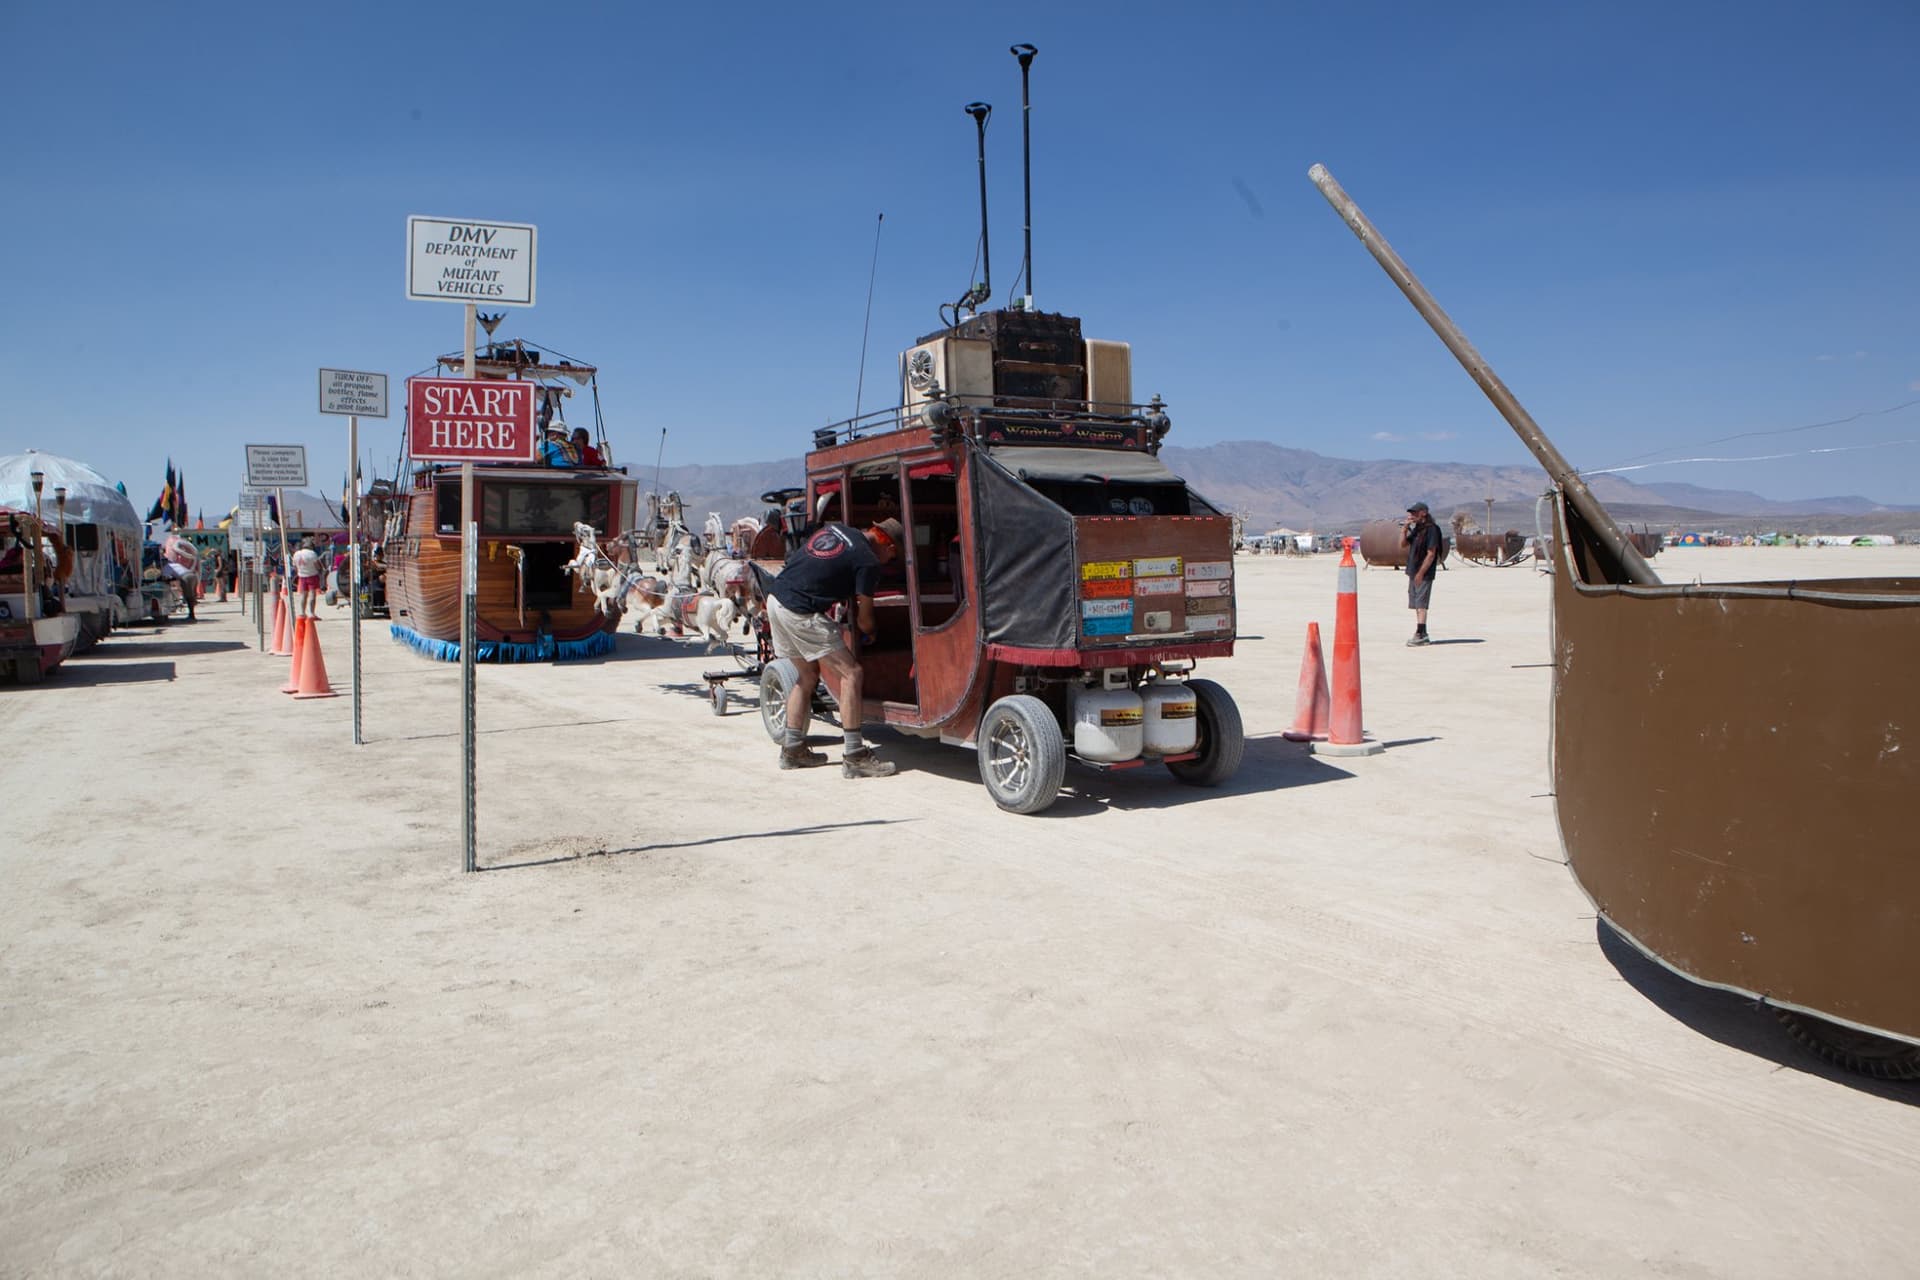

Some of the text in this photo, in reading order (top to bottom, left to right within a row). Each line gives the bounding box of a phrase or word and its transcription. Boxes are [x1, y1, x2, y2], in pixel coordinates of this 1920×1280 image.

[449, 226, 497, 245] DMV
[425, 242, 518, 260] DEPARTMENT
[464, 258, 478, 268] of
[442, 267, 500, 282] MUTANT
[437, 280, 504, 296] VEHICLES
[334, 372, 355, 382] TURN
[344, 382, 374, 391] propane
[340, 396, 366, 404] effects
[357, 390, 378, 398] flame
[424, 386, 521, 417] START
[429, 420, 516, 450] HERE
[1006, 425, 1062, 437] Wonder
